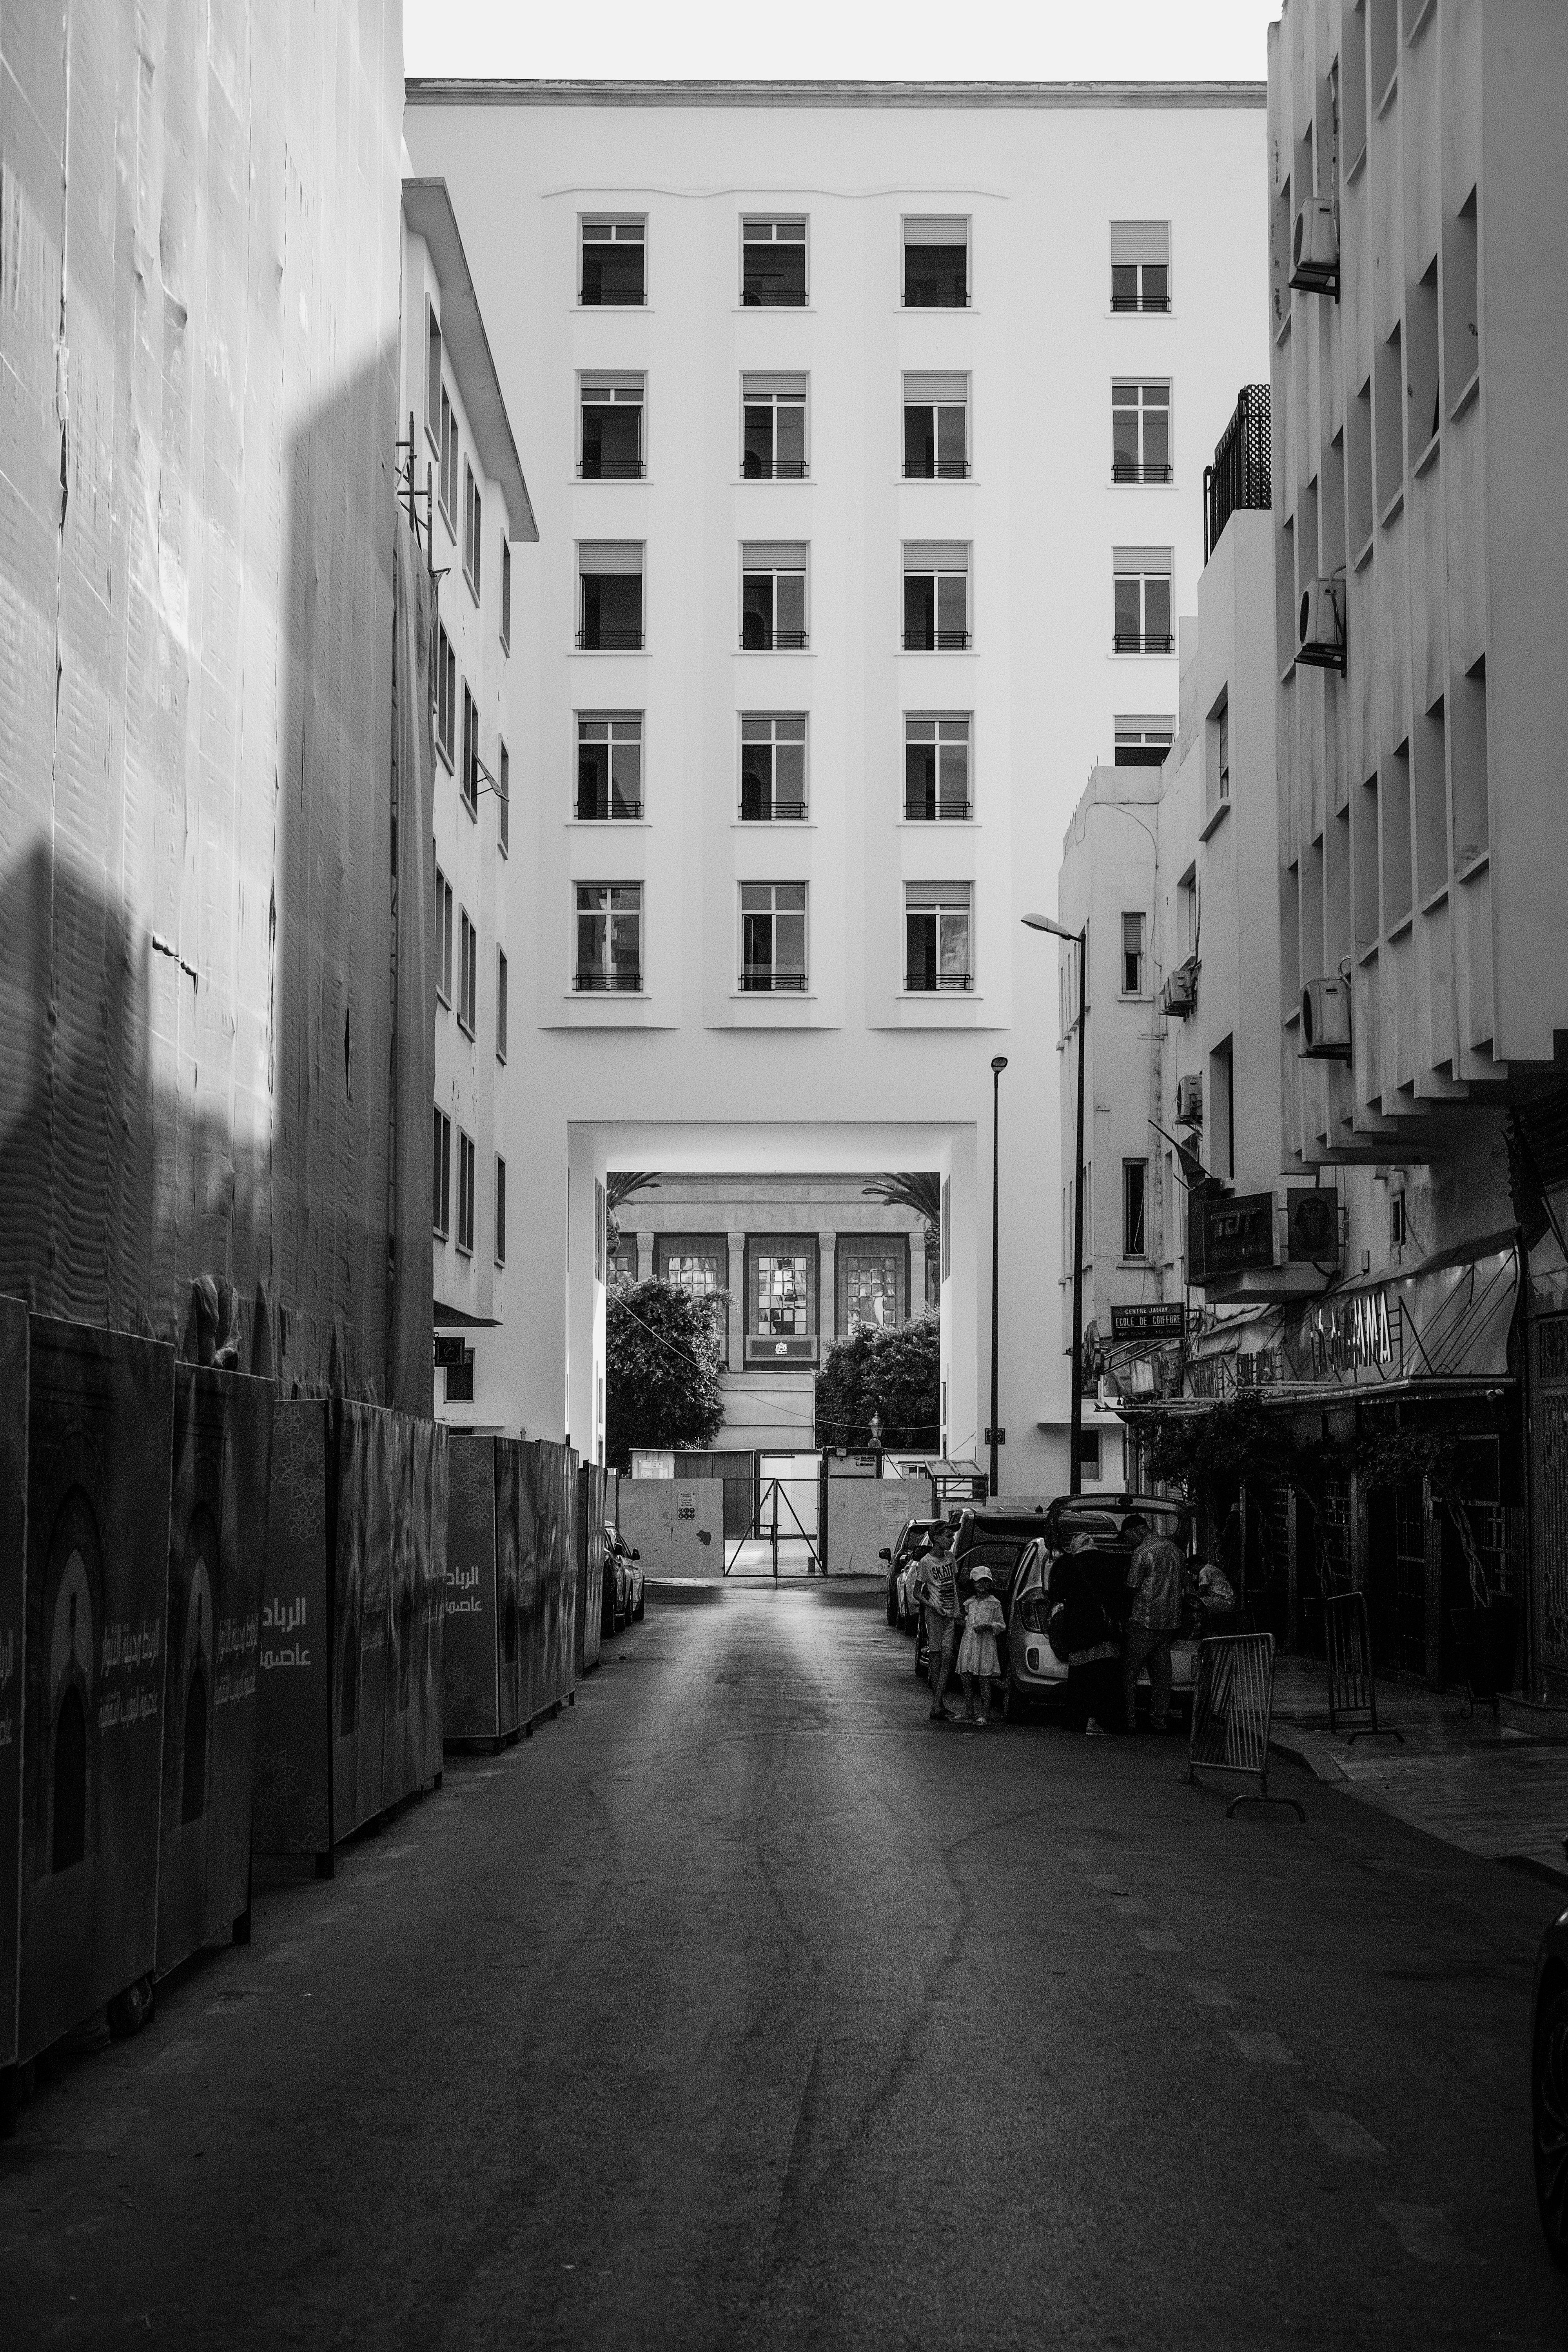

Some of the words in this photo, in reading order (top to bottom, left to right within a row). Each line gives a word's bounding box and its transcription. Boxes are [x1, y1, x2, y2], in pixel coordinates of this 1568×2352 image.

[1116, 1317, 1134, 1327] ECOLE
[1139, 1316, 1147, 1325] DE
[1152, 1315, 1181, 1324] COIFFURE
[932, 1563, 953, 1579] SKATE
